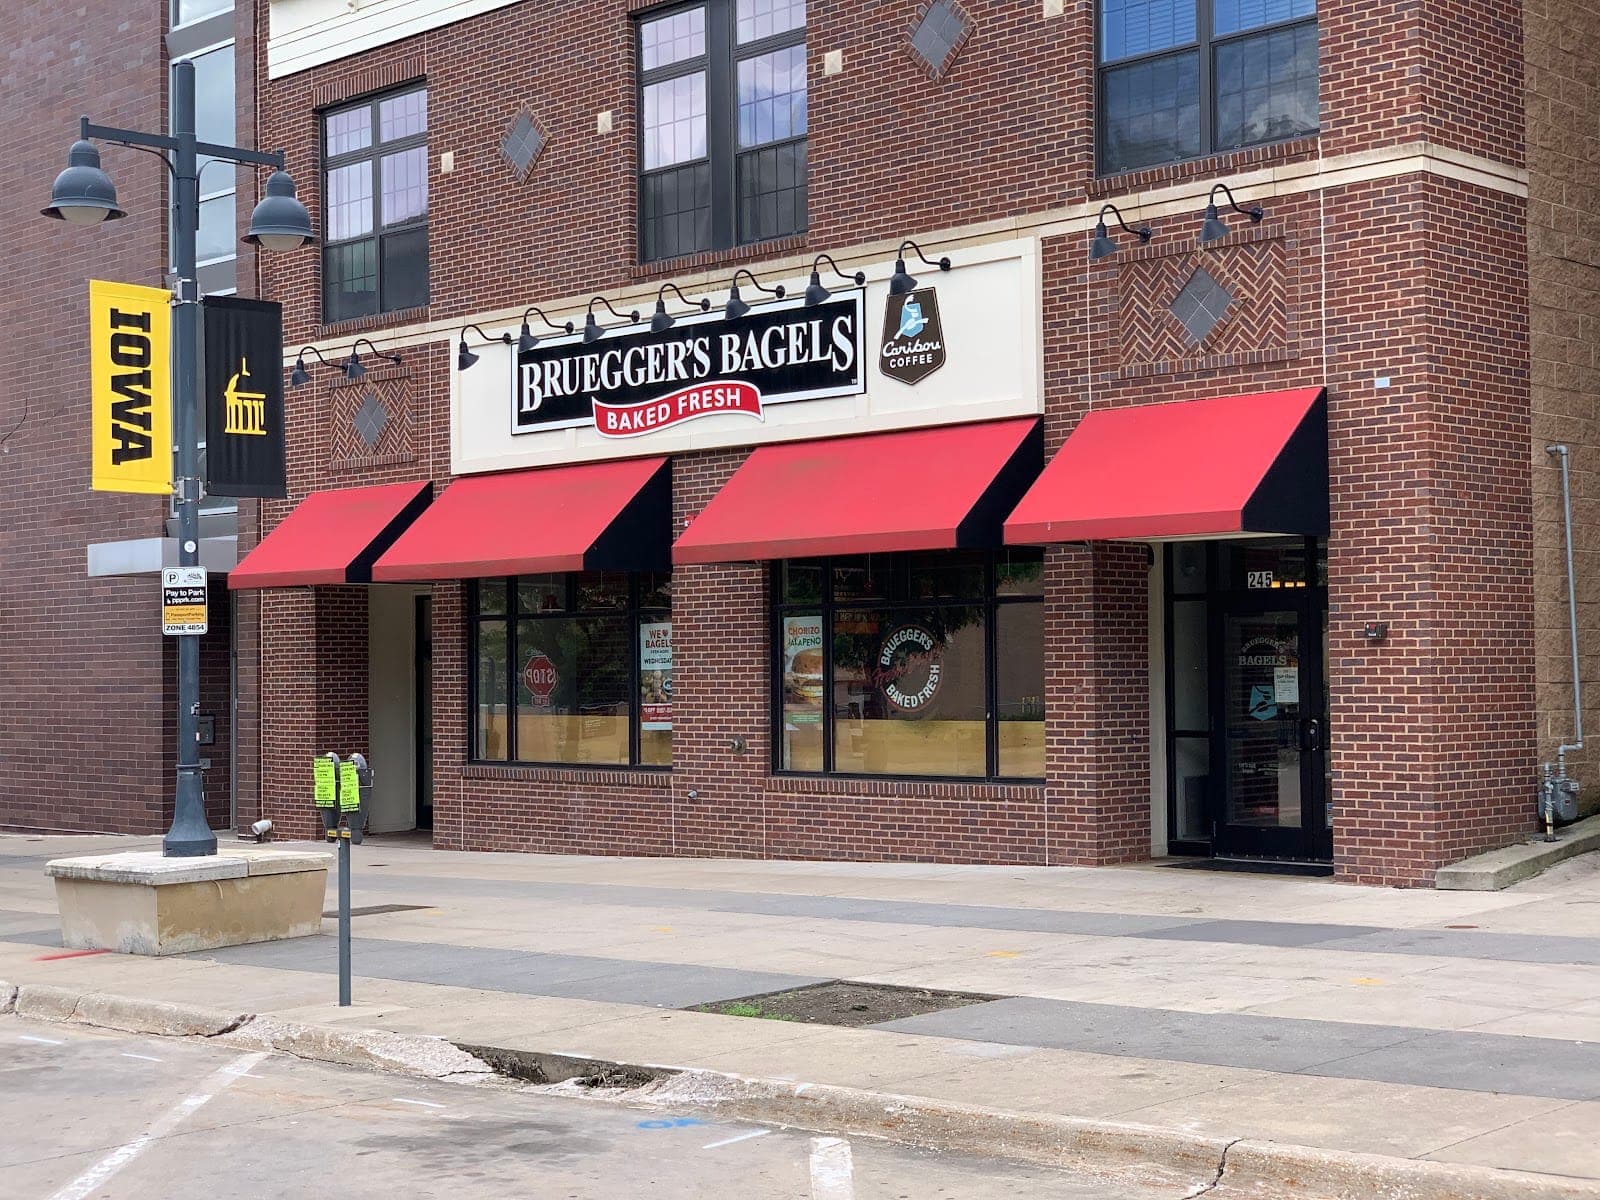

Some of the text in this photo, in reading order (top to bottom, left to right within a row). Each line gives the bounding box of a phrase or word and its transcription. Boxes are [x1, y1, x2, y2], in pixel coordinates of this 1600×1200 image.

[882, 339, 941, 358] Caribou
[520, 314, 854, 413] BRUEGGER'S BAGELS
[889, 353, 933, 368] COFFEE
[110, 308, 152, 465] IOWA
[606, 388, 741, 432] BAKED FRESH
[1249, 573, 1272, 587] 245
[165, 589, 179, 597] Pay
[649, 629, 662, 639] WE
[788, 626, 820, 635] CHORIZO
[645, 639, 672, 649] BAGELS
[880, 628, 933, 666] BRUEGGER'S
[1238, 655, 1287, 666] BAGELS
[885, 683, 918, 708] BAKED
[918, 664, 940, 705] FRESH
